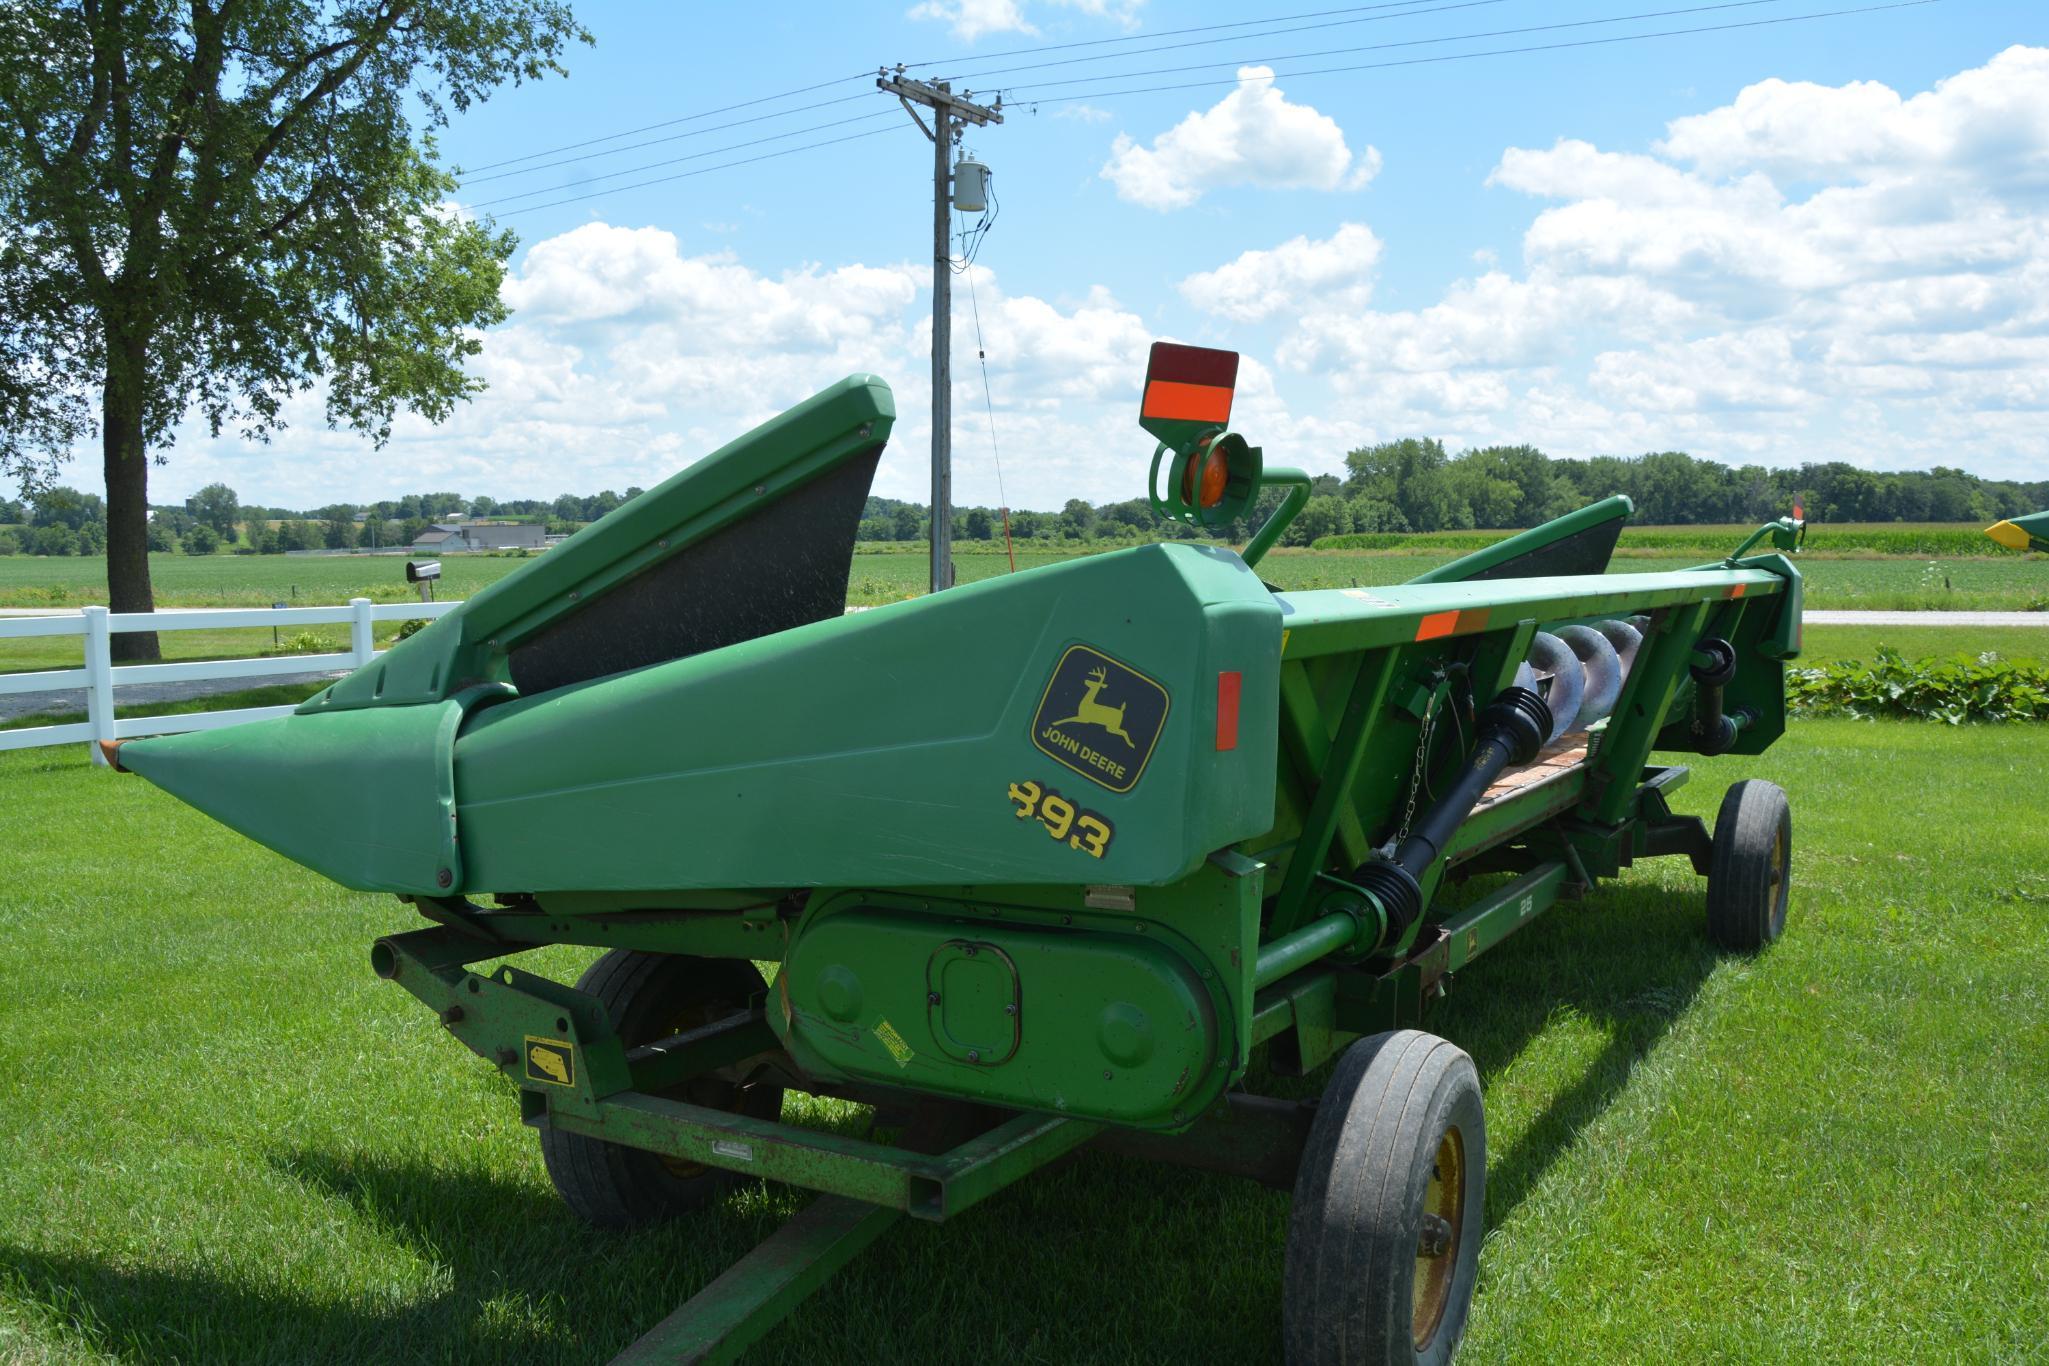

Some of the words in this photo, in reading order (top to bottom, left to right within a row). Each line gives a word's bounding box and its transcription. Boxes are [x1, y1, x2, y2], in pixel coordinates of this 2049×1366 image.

[1042, 727, 1080, 754] JOHN
[1079, 746, 1126, 780] DEERE
[1519, 895, 1533, 917] 25
